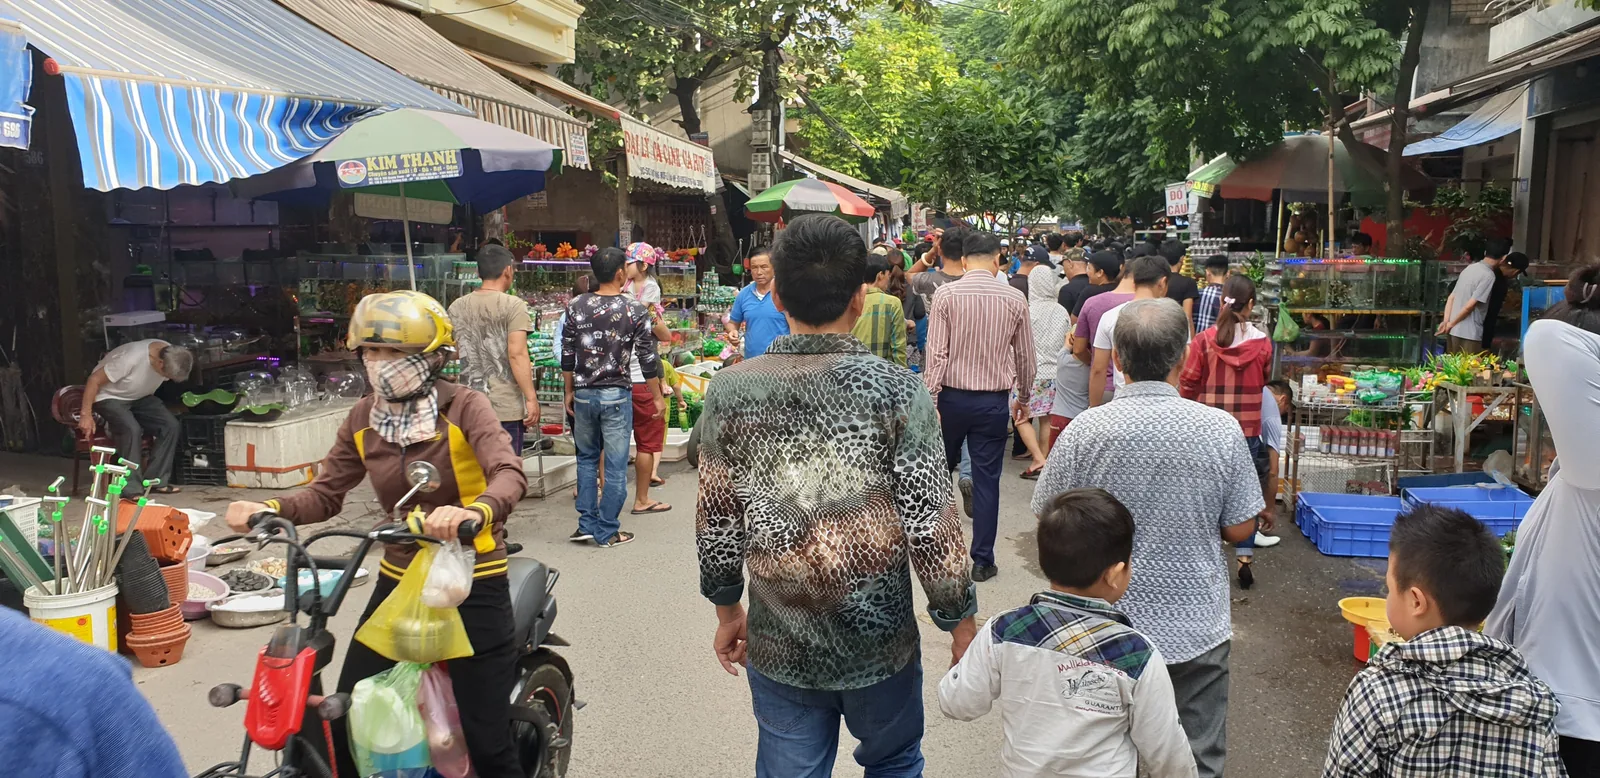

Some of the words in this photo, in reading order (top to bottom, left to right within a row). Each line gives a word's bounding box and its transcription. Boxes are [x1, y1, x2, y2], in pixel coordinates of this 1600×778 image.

[366, 156, 398, 171] KIM
[400, 150, 458, 168] THANH
[593, 303, 609, 314] GUCCI
